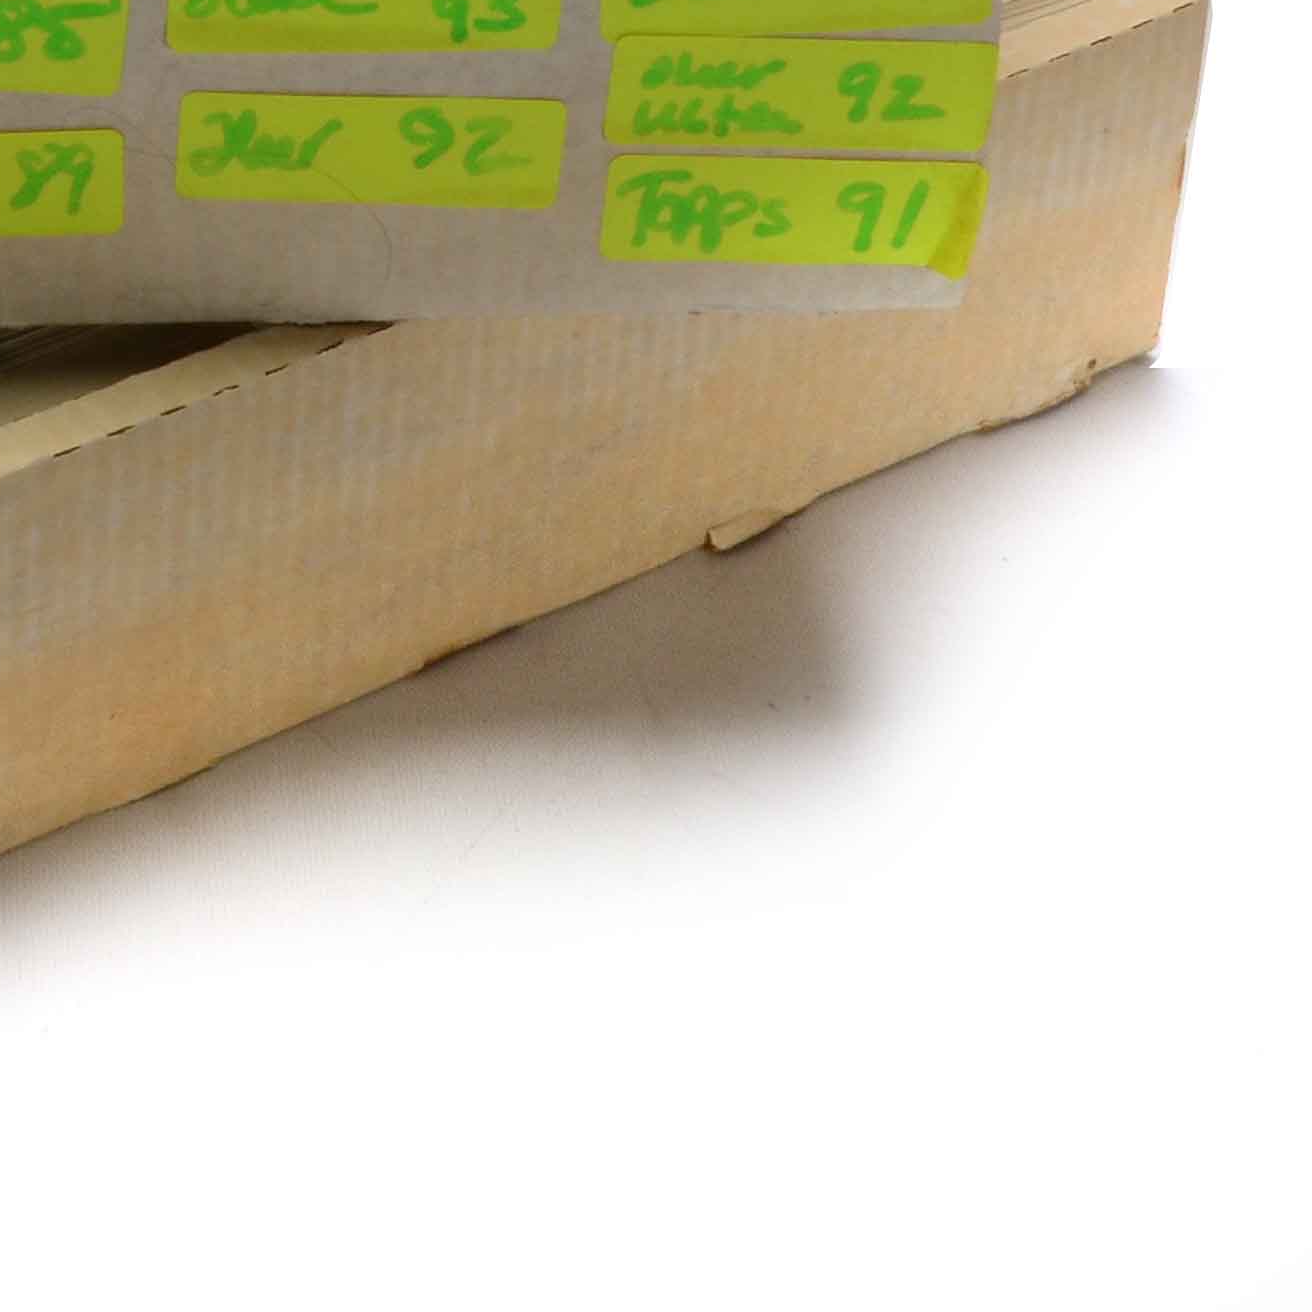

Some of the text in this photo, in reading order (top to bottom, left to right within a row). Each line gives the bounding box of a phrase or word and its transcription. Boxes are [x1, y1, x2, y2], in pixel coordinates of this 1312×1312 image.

[837, 60, 946, 124] 92
[399, 107, 532, 176] 92
[837, 179, 930, 253] 91
